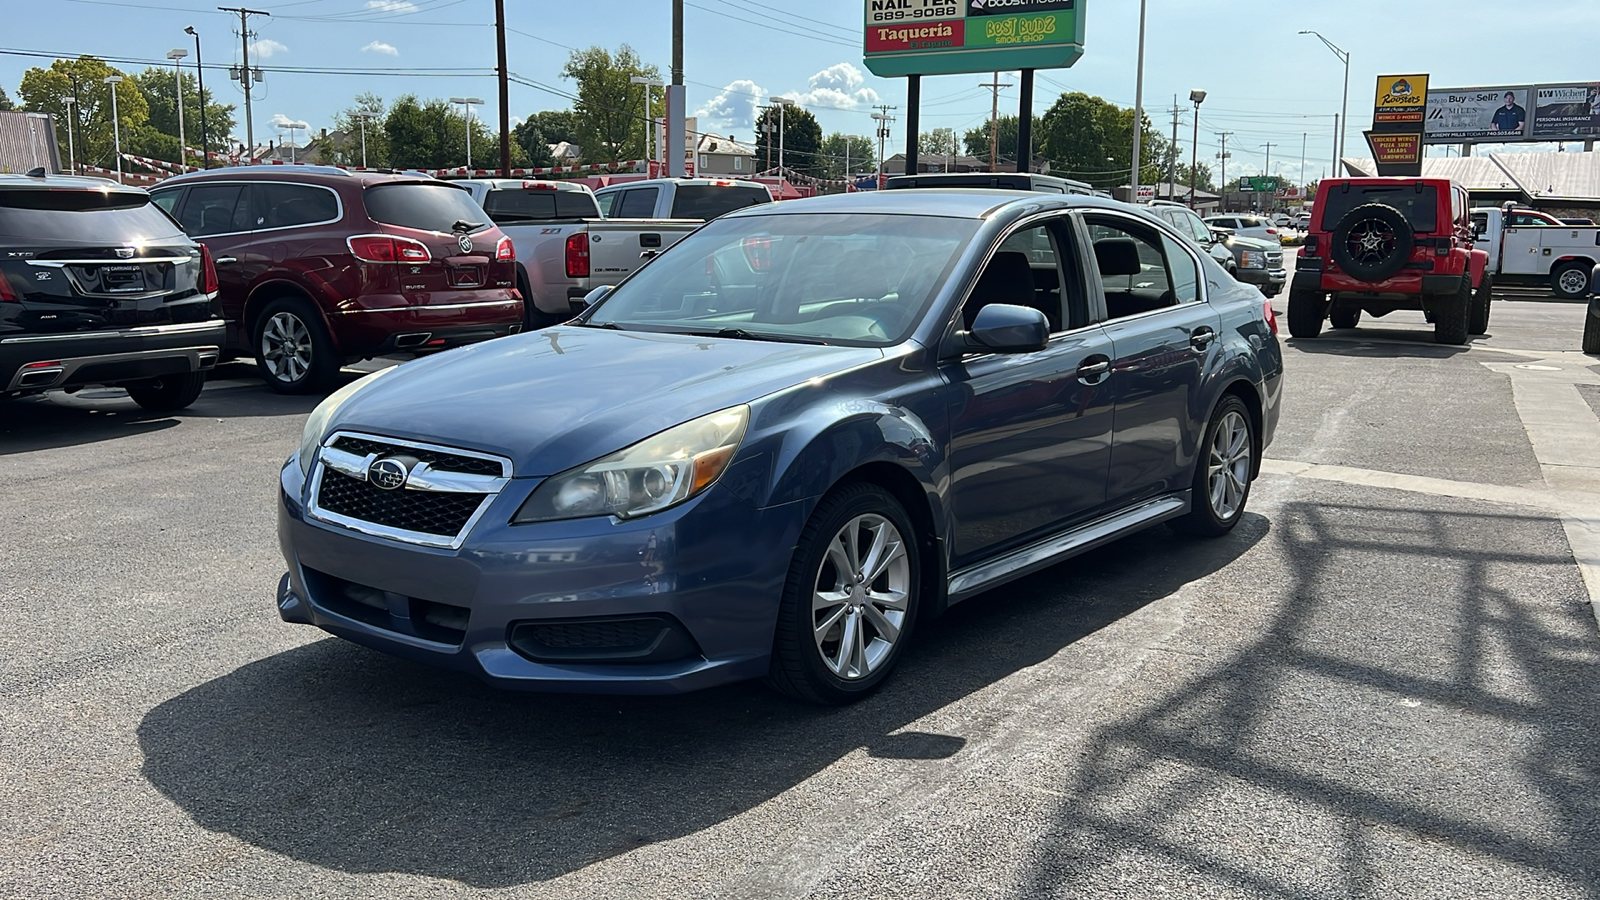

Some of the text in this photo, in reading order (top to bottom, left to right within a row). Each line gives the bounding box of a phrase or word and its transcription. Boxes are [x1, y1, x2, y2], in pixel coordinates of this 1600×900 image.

[871, 0, 912, 11] NAIL
[873, 7, 956, 21] 689-9088
[995, 34, 1045, 44] SMOKE SHOP
[1448, 95, 1466, 104] Buy
[1476, 93, 1498, 102] Sell?
[1554, 89, 1585, 98] Wichert
[1381, 94, 1420, 106] Roosters
